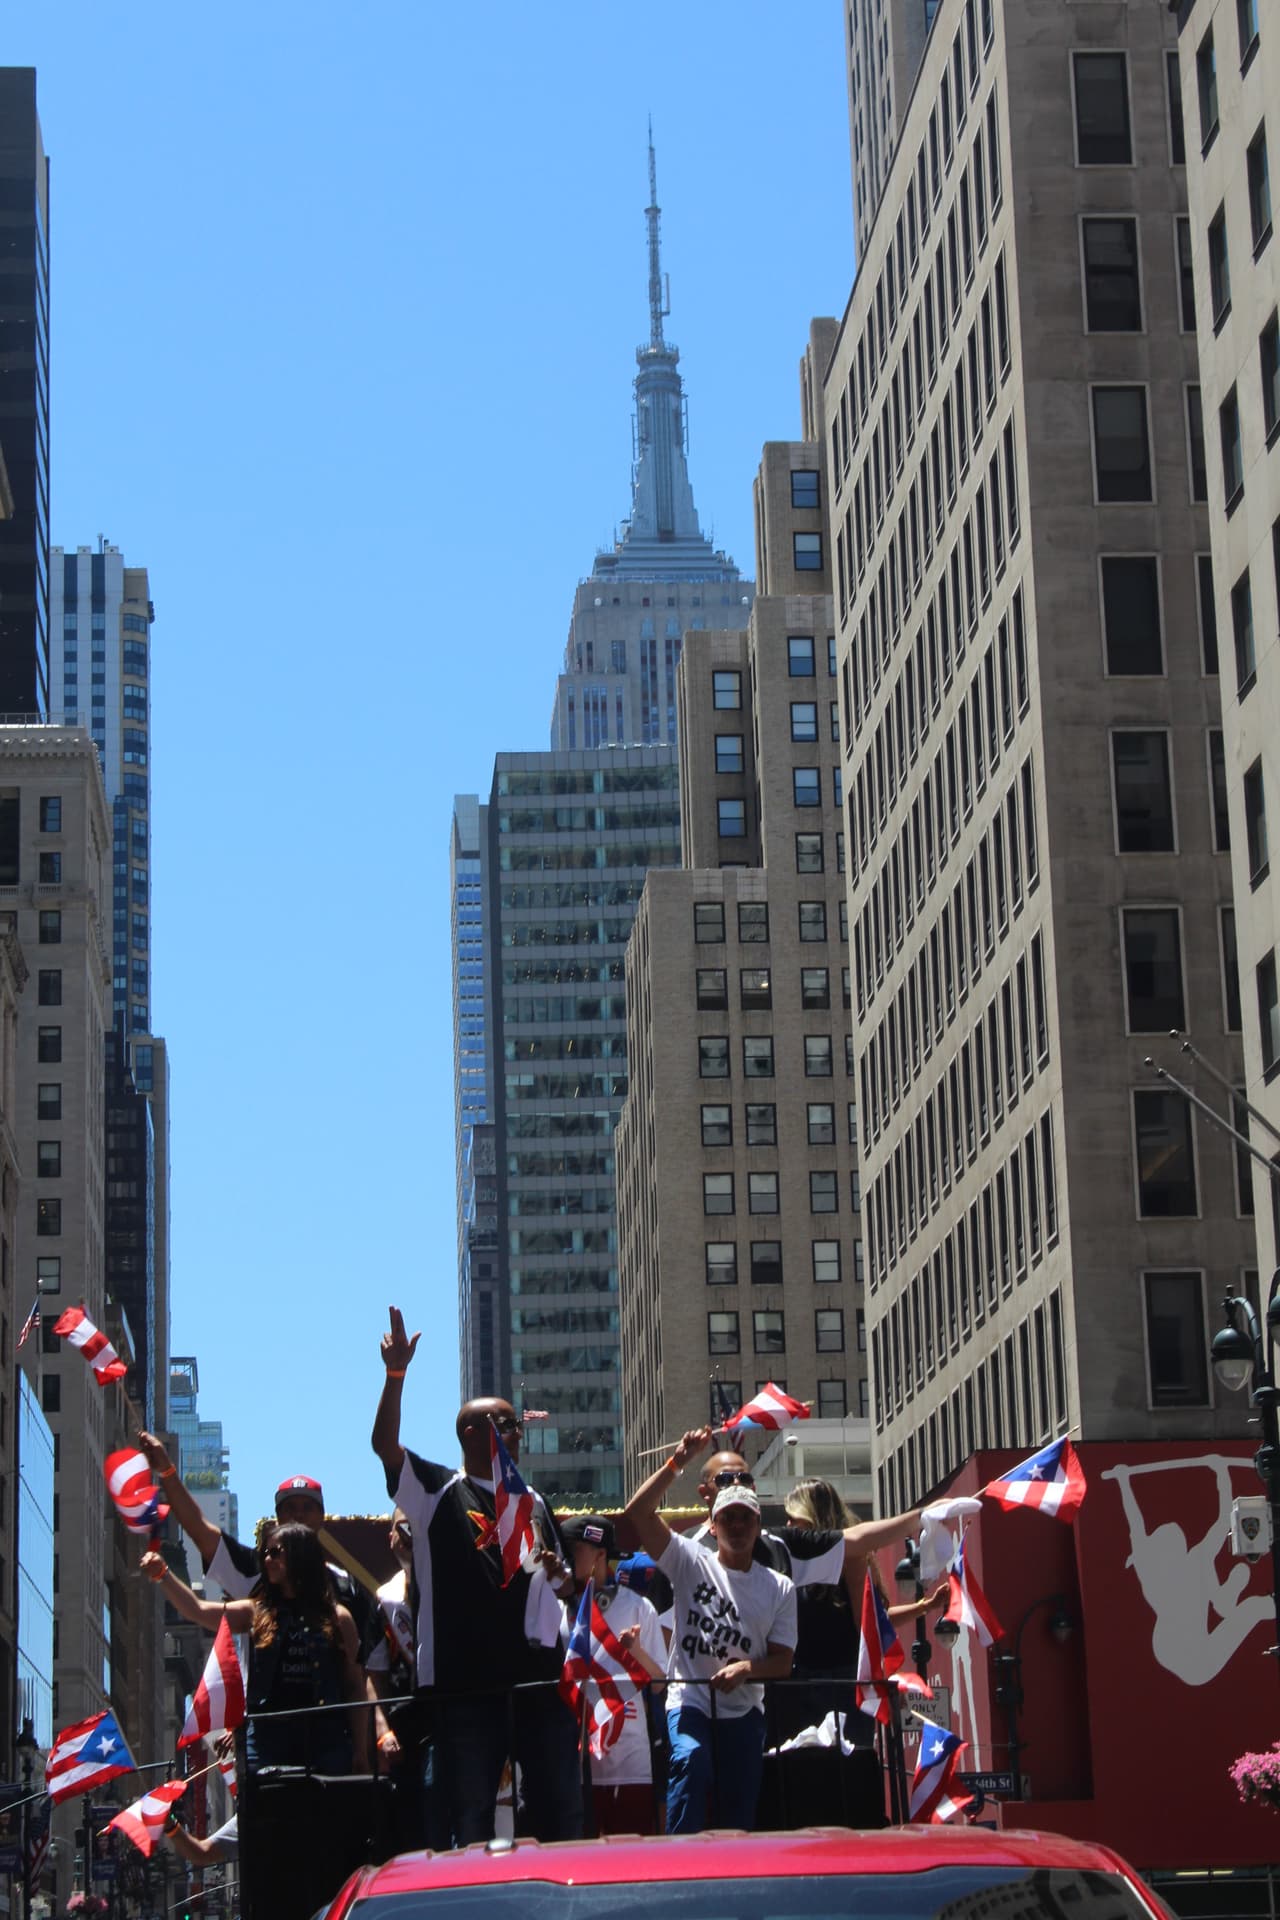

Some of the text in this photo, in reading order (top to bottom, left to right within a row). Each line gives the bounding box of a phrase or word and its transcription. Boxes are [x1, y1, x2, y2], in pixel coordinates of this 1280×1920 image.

[908, 1692, 940, 1701] BUS
[911, 1703, 937, 1713] ONLY
[999, 1777, 1010, 1789] St
